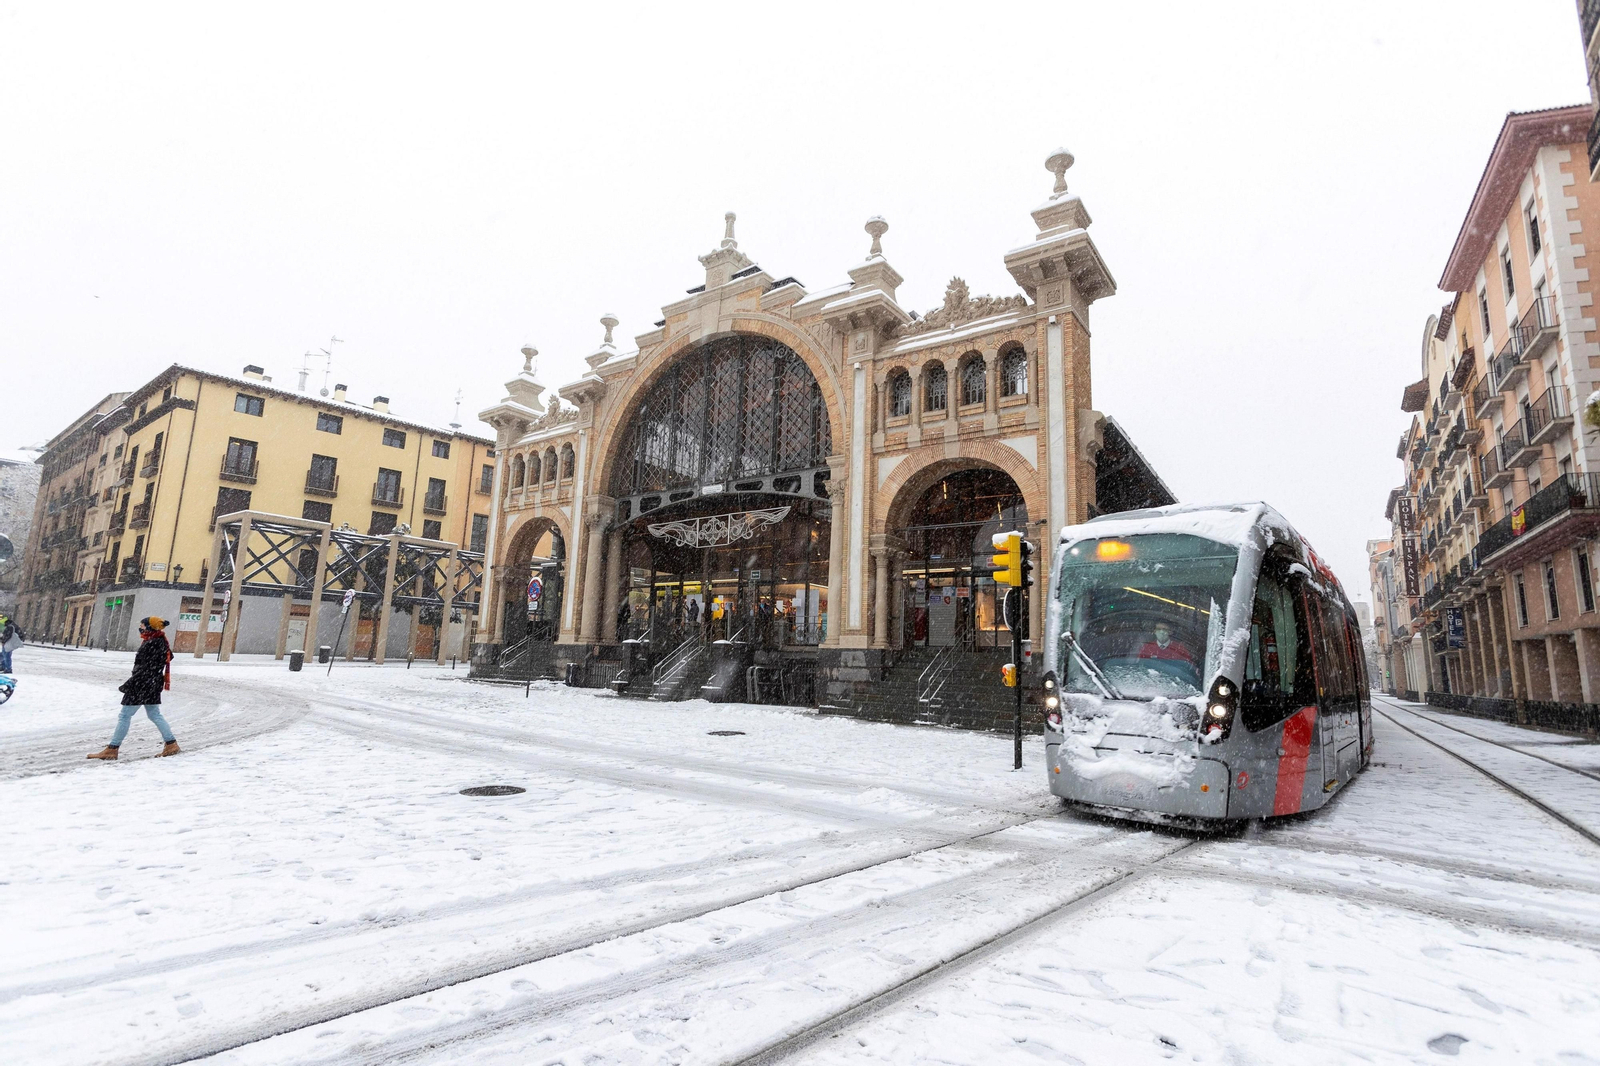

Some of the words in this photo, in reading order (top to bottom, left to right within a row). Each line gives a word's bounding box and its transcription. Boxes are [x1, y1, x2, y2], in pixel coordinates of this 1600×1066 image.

[1401, 500, 1410, 533] HOTEL
[1404, 540, 1416, 595] HISPANIA
[179, 613, 216, 621] EXCOA
[1447, 609, 1456, 636] HOTEL
